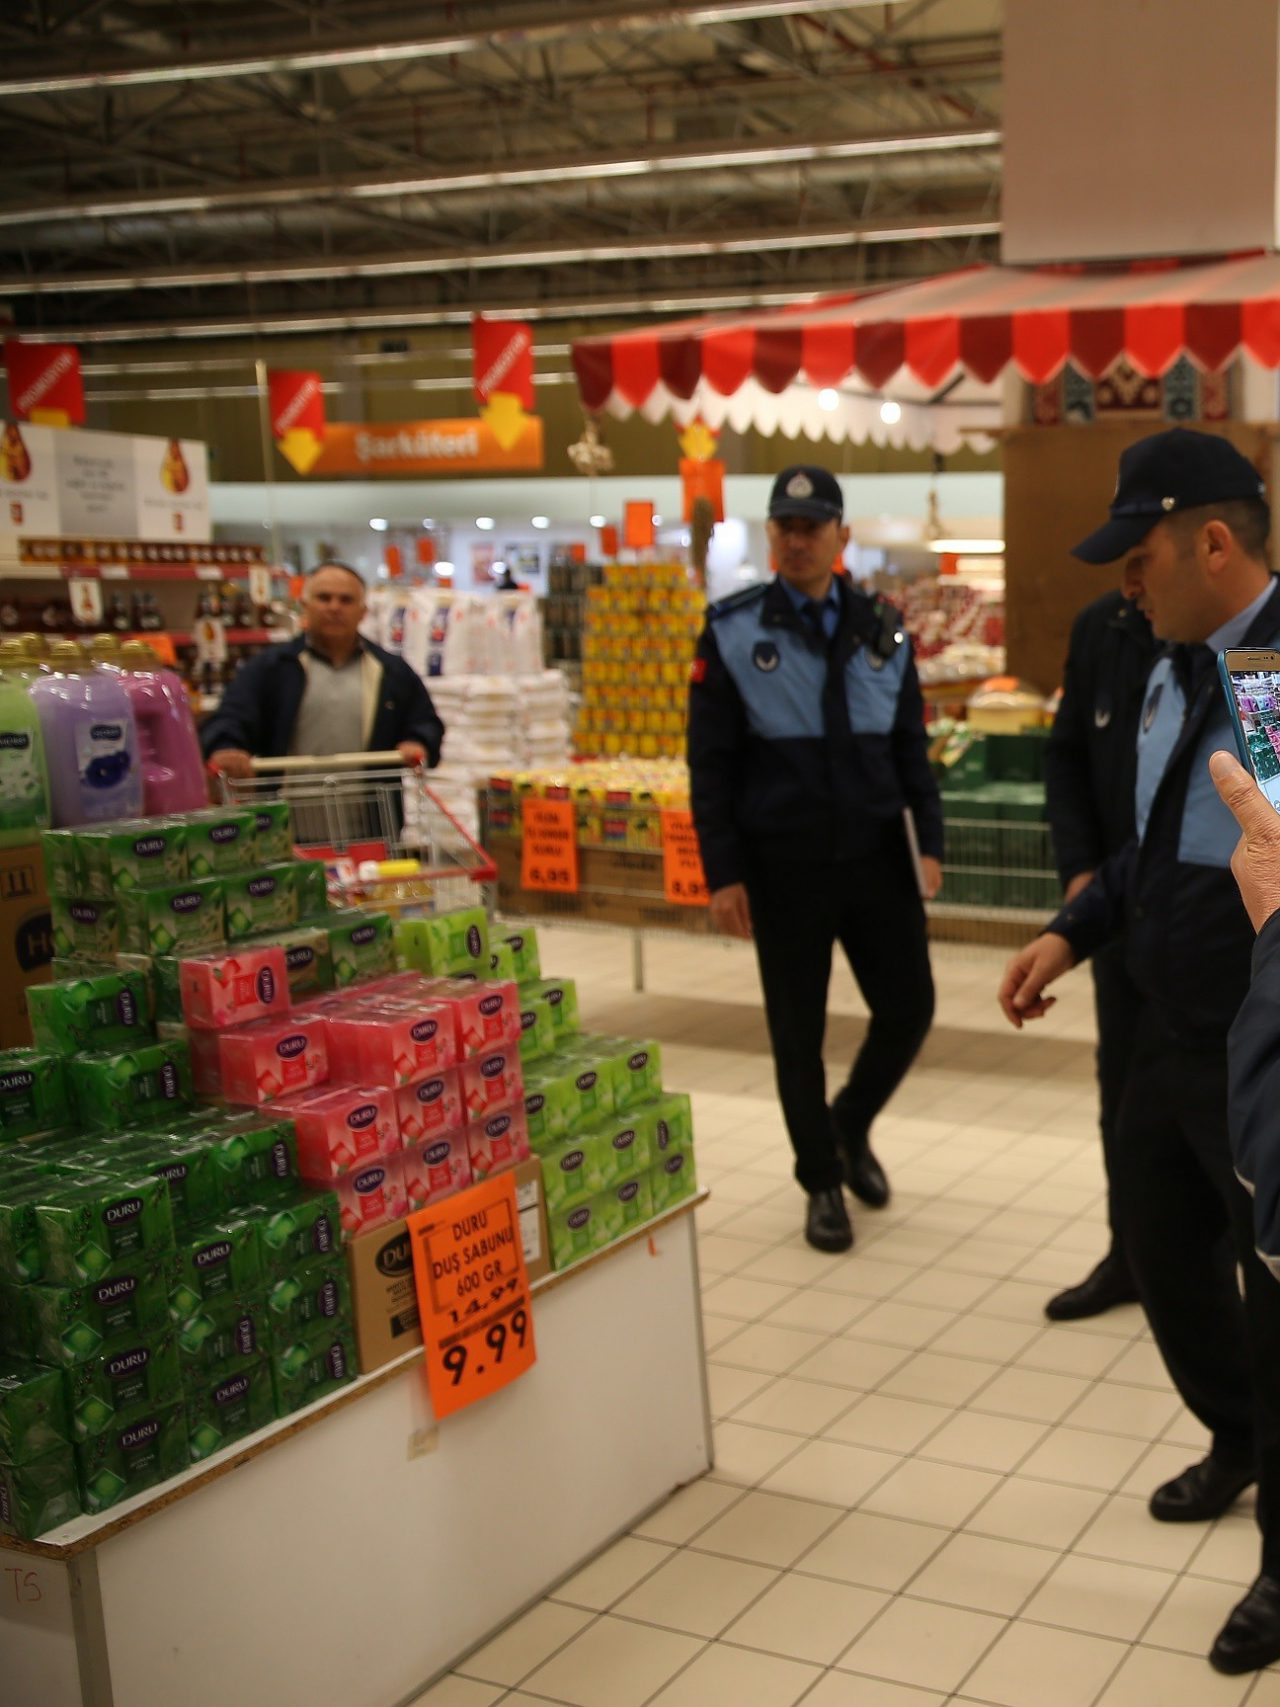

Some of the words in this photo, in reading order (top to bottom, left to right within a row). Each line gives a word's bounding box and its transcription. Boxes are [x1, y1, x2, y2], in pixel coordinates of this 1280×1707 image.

[158, 1166, 186, 1179] URU
[106, 1201, 141, 1222] DURU
[452, 1211, 489, 1242] DURU
[197, 1244, 230, 1265] DURU
[433, 1254, 460, 1280] DUŞ
[463, 1226, 514, 1266] SABUNU
[98, 1279, 135, 1300] DURU
[456, 1274, 480, 1297] 600
[483, 1260, 502, 1286] GR
[442, 1311, 528, 1387] 9.99
[109, 1352, 147, 1374] DURU
[216, 1378, 248, 1402] DURU
[122, 1423, 158, 1447] DURU
